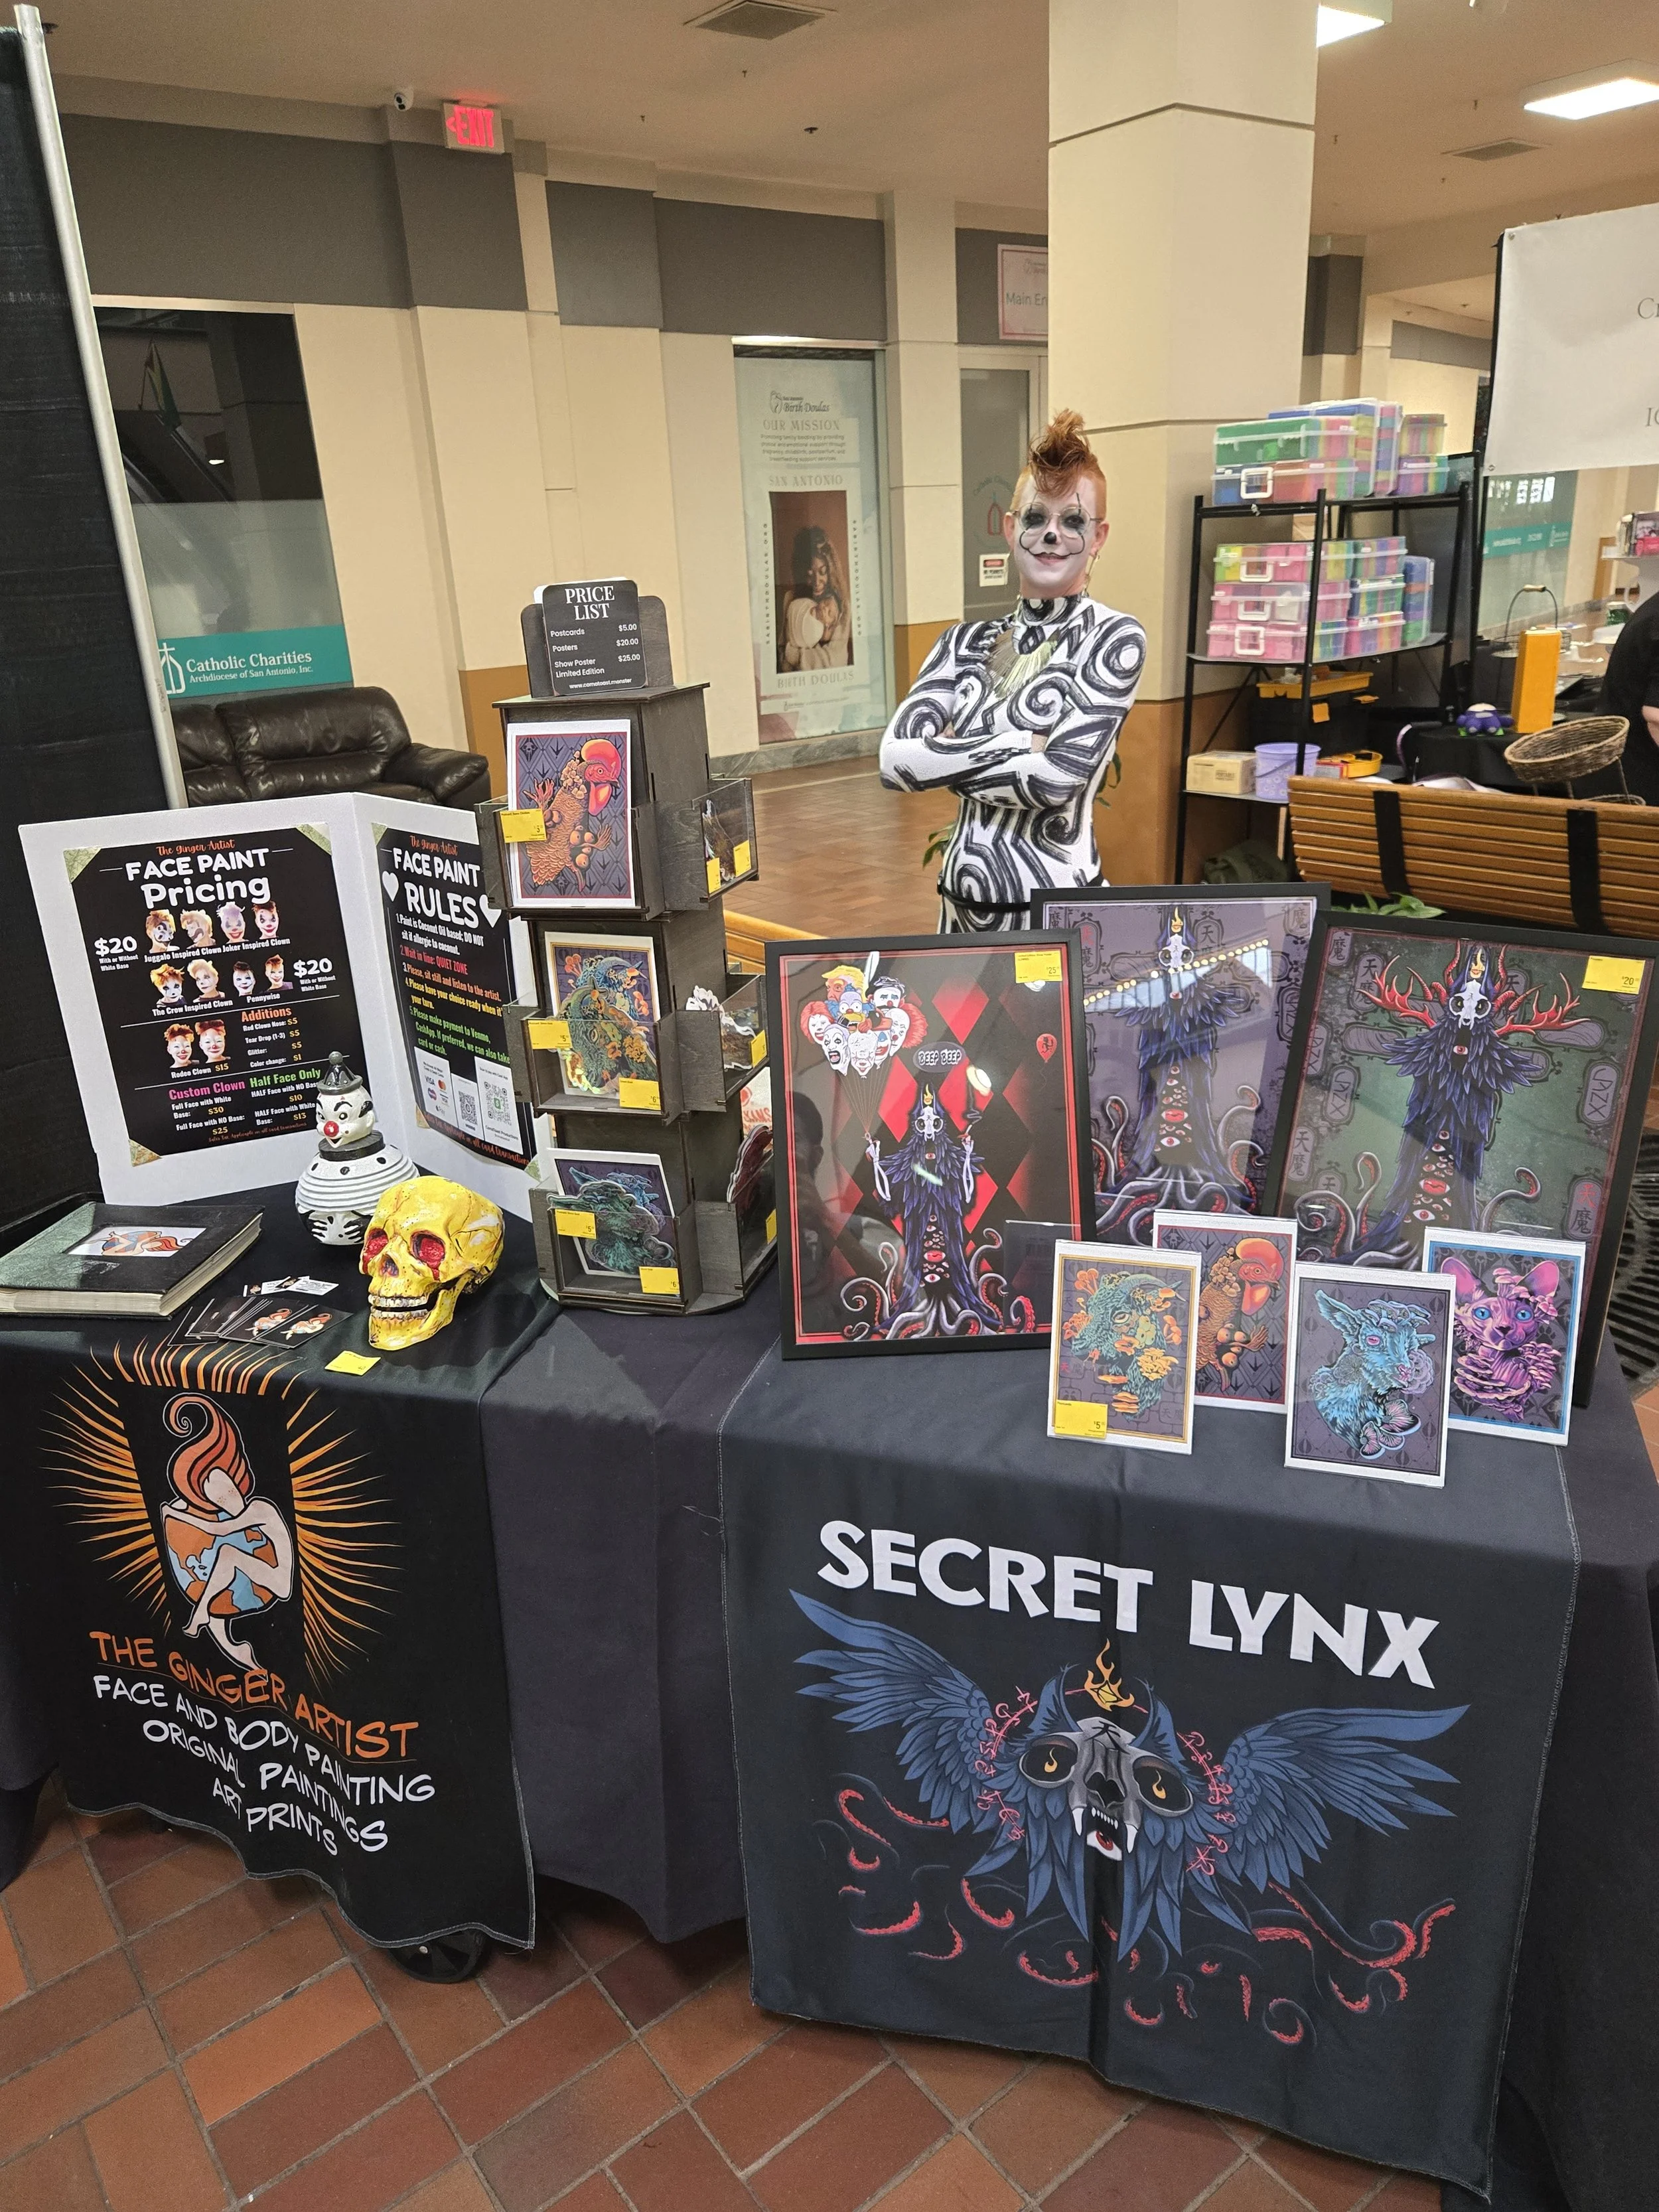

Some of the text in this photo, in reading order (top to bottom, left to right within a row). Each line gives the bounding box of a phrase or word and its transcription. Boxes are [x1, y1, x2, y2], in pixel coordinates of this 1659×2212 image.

[454, 105, 494, 148] EXIT
[1006, 292, 1031, 305] Main
[763, 419, 839, 431] OUR MISSION
[769, 475, 843, 486] SAN ANTONIO
[565, 585, 615, 604] PRICE
[573, 603, 610, 621] LIST
[550, 623, 637, 637] Postcards $5.00
[552, 644, 578, 652] Posters
[186, 650, 313, 672] Catholic Charities
[618, 654, 641, 662] $25.00
[189, 672, 238, 683] Archdiocese
[240, 669, 249, 678] of
[249, 669, 264, 678] San
[555, 667, 605, 678] Limited Edition
[811, 671, 854, 686] DOULAS
[156, 839, 236, 856] The Ginger Artist
[409, 836, 421, 848] The
[125, 848, 269, 881] FACE PAINT
[393, 848, 480, 887] FACE PAINT
[140, 874, 271, 909] Pricing
[404, 881, 478, 928] RULES
[413, 918, 417, 928] is
[464, 931, 472, 944] DO
[94, 936, 137, 956] $20
[222, 938, 291, 953] Joker Inspired Clown
[144, 946, 221, 963] Juggalo Inspired Clown
[293, 958, 332, 978] $20
[436, 956, 452, 970] QUIET
[453, 960, 469, 975] ZONE
[431, 973, 441, 983] still
[443, 977, 452, 987] and
[452, 978, 467, 991] listen
[468, 983, 473, 994] to
[474, 985, 483, 996] the
[184, 1001, 212, 1013] Inspired
[213, 999, 233, 1007] Clown
[246, 993, 280, 1003] Pennywise
[411, 995, 421, 1005] your
[425, 984, 437, 996] have
[437, 989, 448, 1000] your
[449, 992, 466, 1005] choice
[466, 999, 481, 1012] ready
[482, 1003, 496, 1015] when
[242, 1007, 292, 1022] Additions
[443, 1019, 464, 1035] payment
[272, 1032, 286, 1041] (1-3)
[265, 1057, 287, 1066] change:
[467, 1043, 474, 1052] we
[475, 1045, 485, 1055] can
[485, 1048, 497, 1060] also
[497, 1051, 510, 1065] take
[918, 1049, 962, 1066] BEEP BEEP
[215, 1063, 229, 1072] $15
[250, 1068, 321, 1088] Half Face Only
[425, 1075, 435, 1086] VISA
[169, 1081, 246, 1100] Custom Clown
[171, 1102, 184, 1110] Full
[208, 1106, 224, 1115] $30
[212, 1126, 228, 1135] $25
[816, 1520, 1441, 1690] SECRET LYNX
[90, 1631, 419, 1759] THE GINGER ARTIST
[93, 1674, 436, 1806] FACE AND BODY PAINTING
[143, 1718, 389, 1853] ORIGINAL PAINTINGS
[212, 1777, 338, 1856] ART PRINTS
